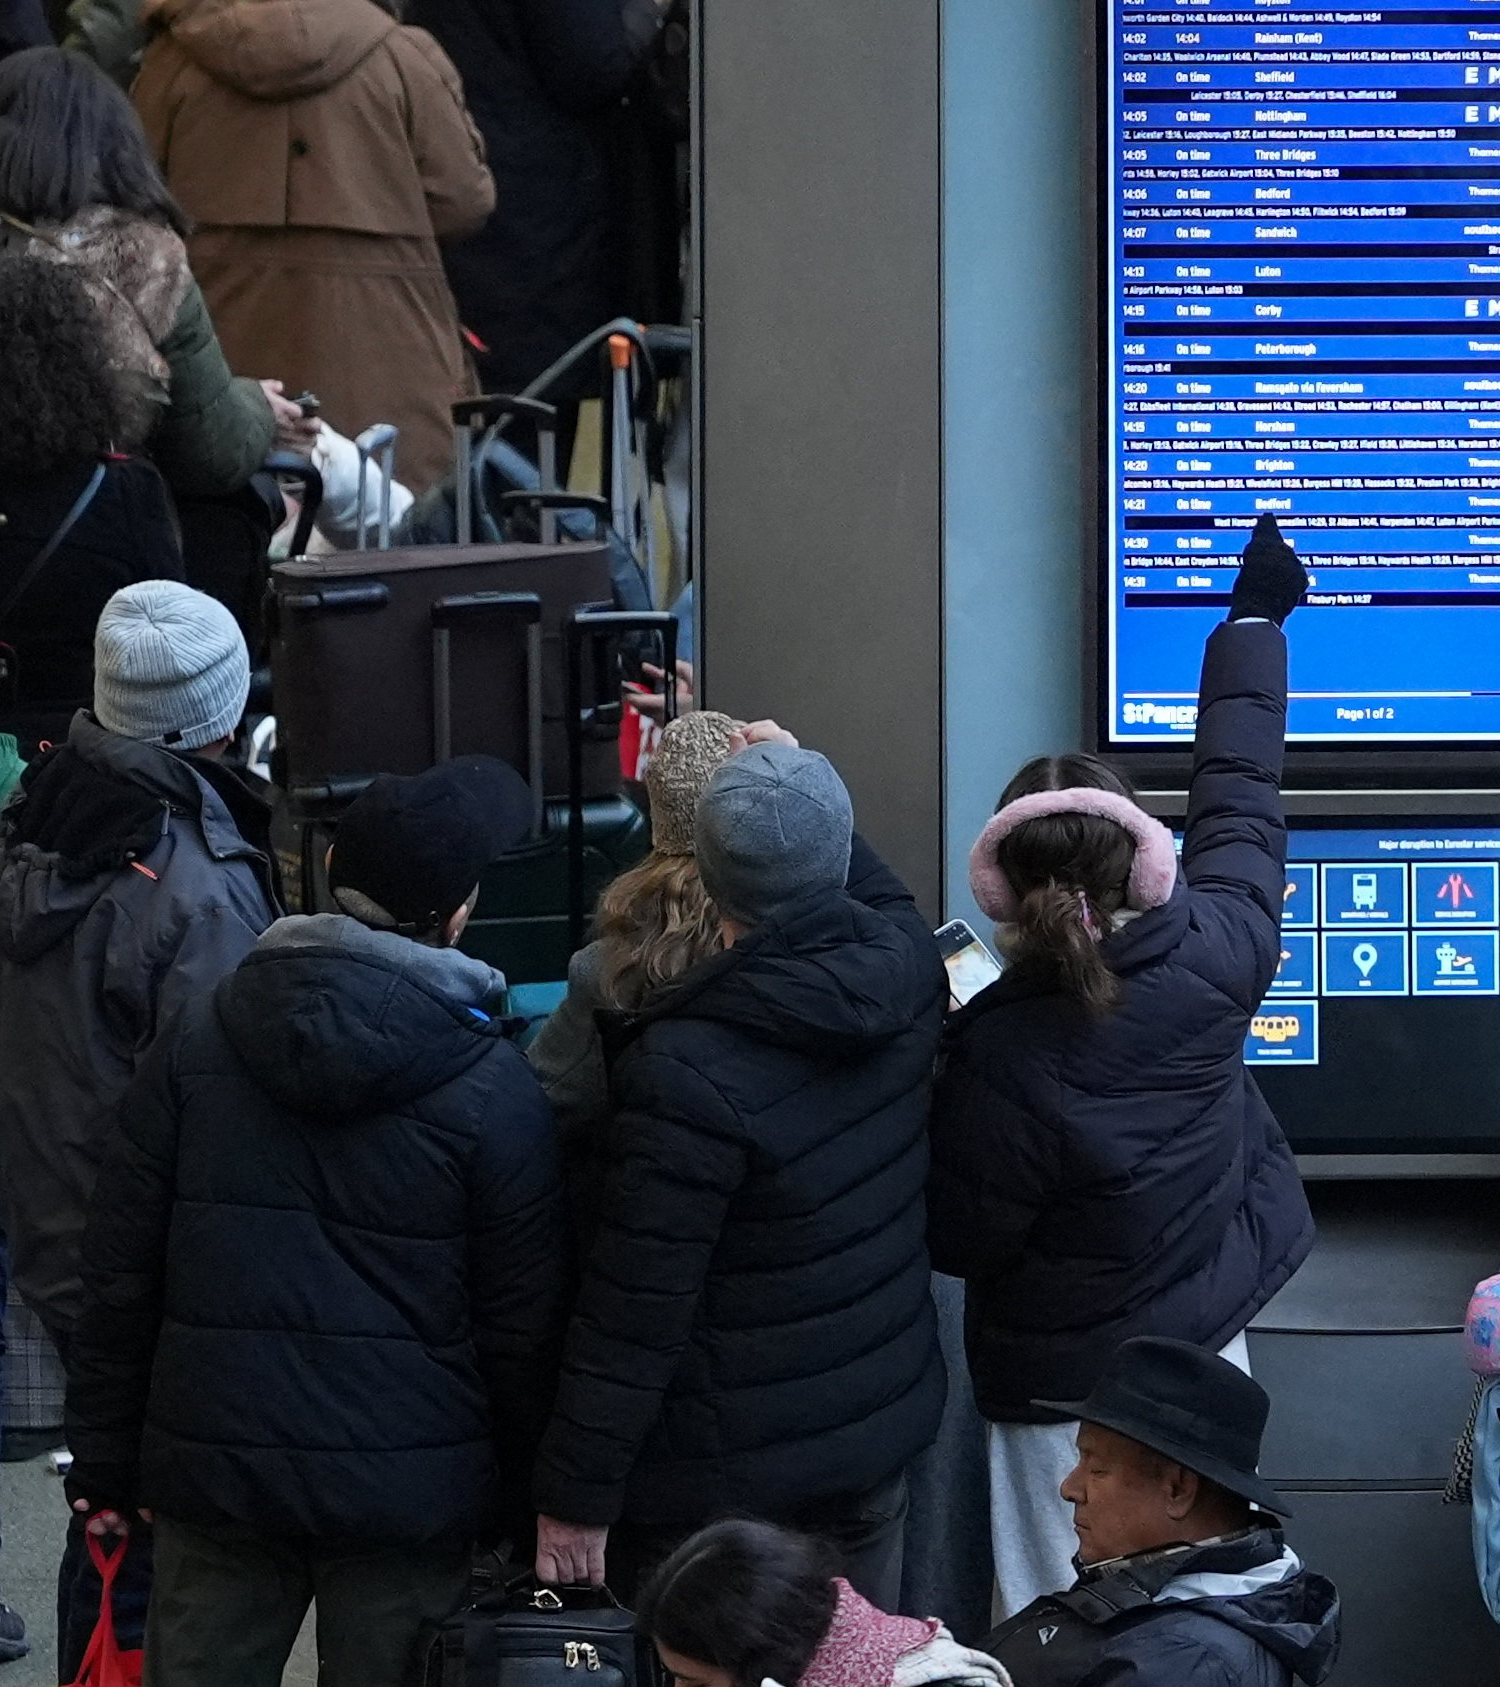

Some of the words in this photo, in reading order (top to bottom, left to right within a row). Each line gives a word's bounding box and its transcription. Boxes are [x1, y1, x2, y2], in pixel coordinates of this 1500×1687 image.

[1122, 32, 1147, 43] 14:02
[1175, 32, 1200, 43] 14:04
[1254, 32, 1294, 43] Rainham
[1294, 32, 1324, 45] (Kent)
[1122, 71, 1147, 82] 14:02
[1176, 71, 1188, 82] On
[1189, 71, 1211, 82] time
[1254, 71, 1295, 82] Sheffield
[1122, 110, 1148, 121] 14:05
[1176, 110, 1188, 121] On
[1189, 110, 1211, 121] time
[1255, 110, 1307, 123] Nottingham
[1122, 149, 1148, 160] 14:05
[1176, 149, 1188, 160] On
[1189, 149, 1211, 160] time
[1255, 149, 1281, 160] Three
[1281, 149, 1317, 162] Bridges
[1122, 188, 1148, 199] 14:06
[1176, 188, 1188, 199] On
[1189, 188, 1211, 199] time
[1255, 188, 1291, 199] Bedford
[1122, 227, 1147, 238] 14:07
[1176, 227, 1188, 238] On
[1189, 227, 1211, 238] time
[1255, 227, 1298, 238] Sandwich
[1336, 707, 1362, 722] Page
[1372, 707, 1385, 720] of
[1386, 707, 1394, 720] 2
